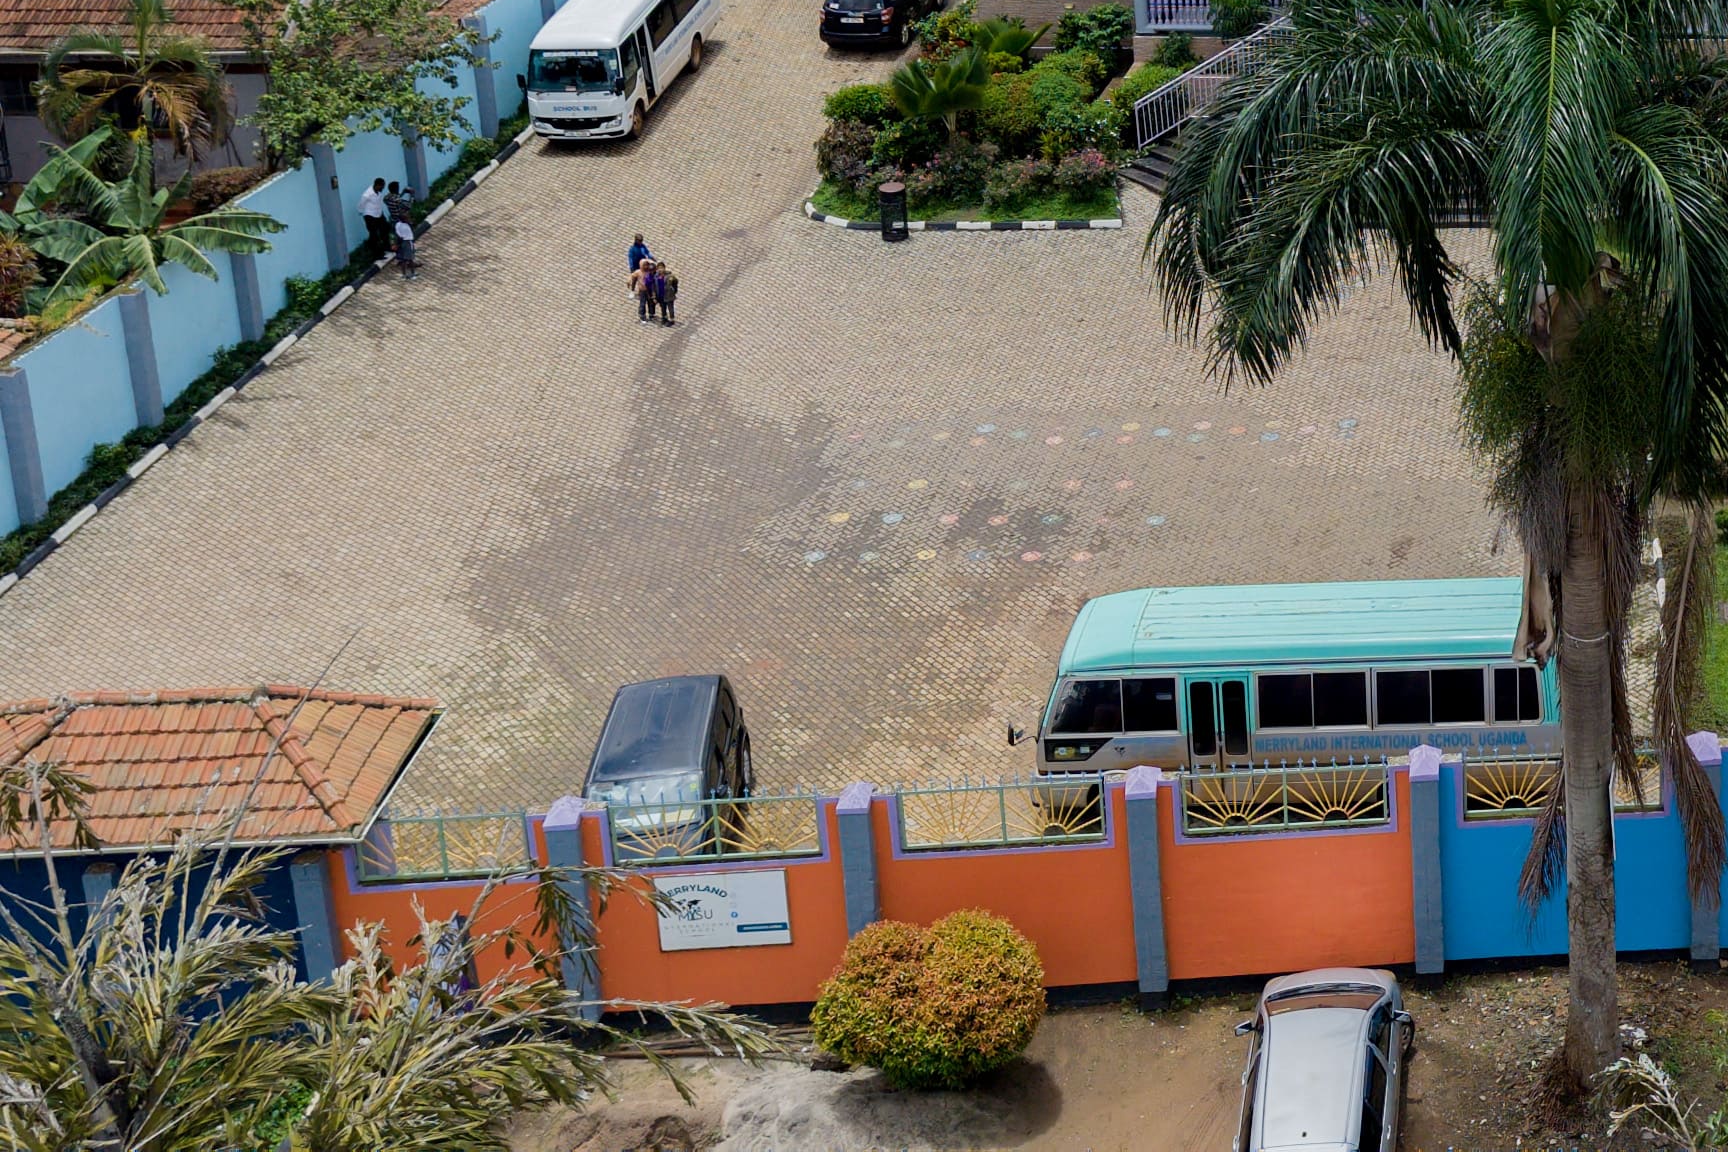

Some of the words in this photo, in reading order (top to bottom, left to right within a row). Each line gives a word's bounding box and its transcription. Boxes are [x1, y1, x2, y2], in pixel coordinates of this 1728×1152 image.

[553, 105, 582, 113] SCHOOL
[1255, 736, 1328, 752] MERRYLAND
[1331, 733, 1421, 751] INTERNATIONAL
[1427, 731, 1475, 749] SCHOOL
[1478, 729, 1528, 746] UGANDA
[662, 884, 728, 900] ERRYLAND
